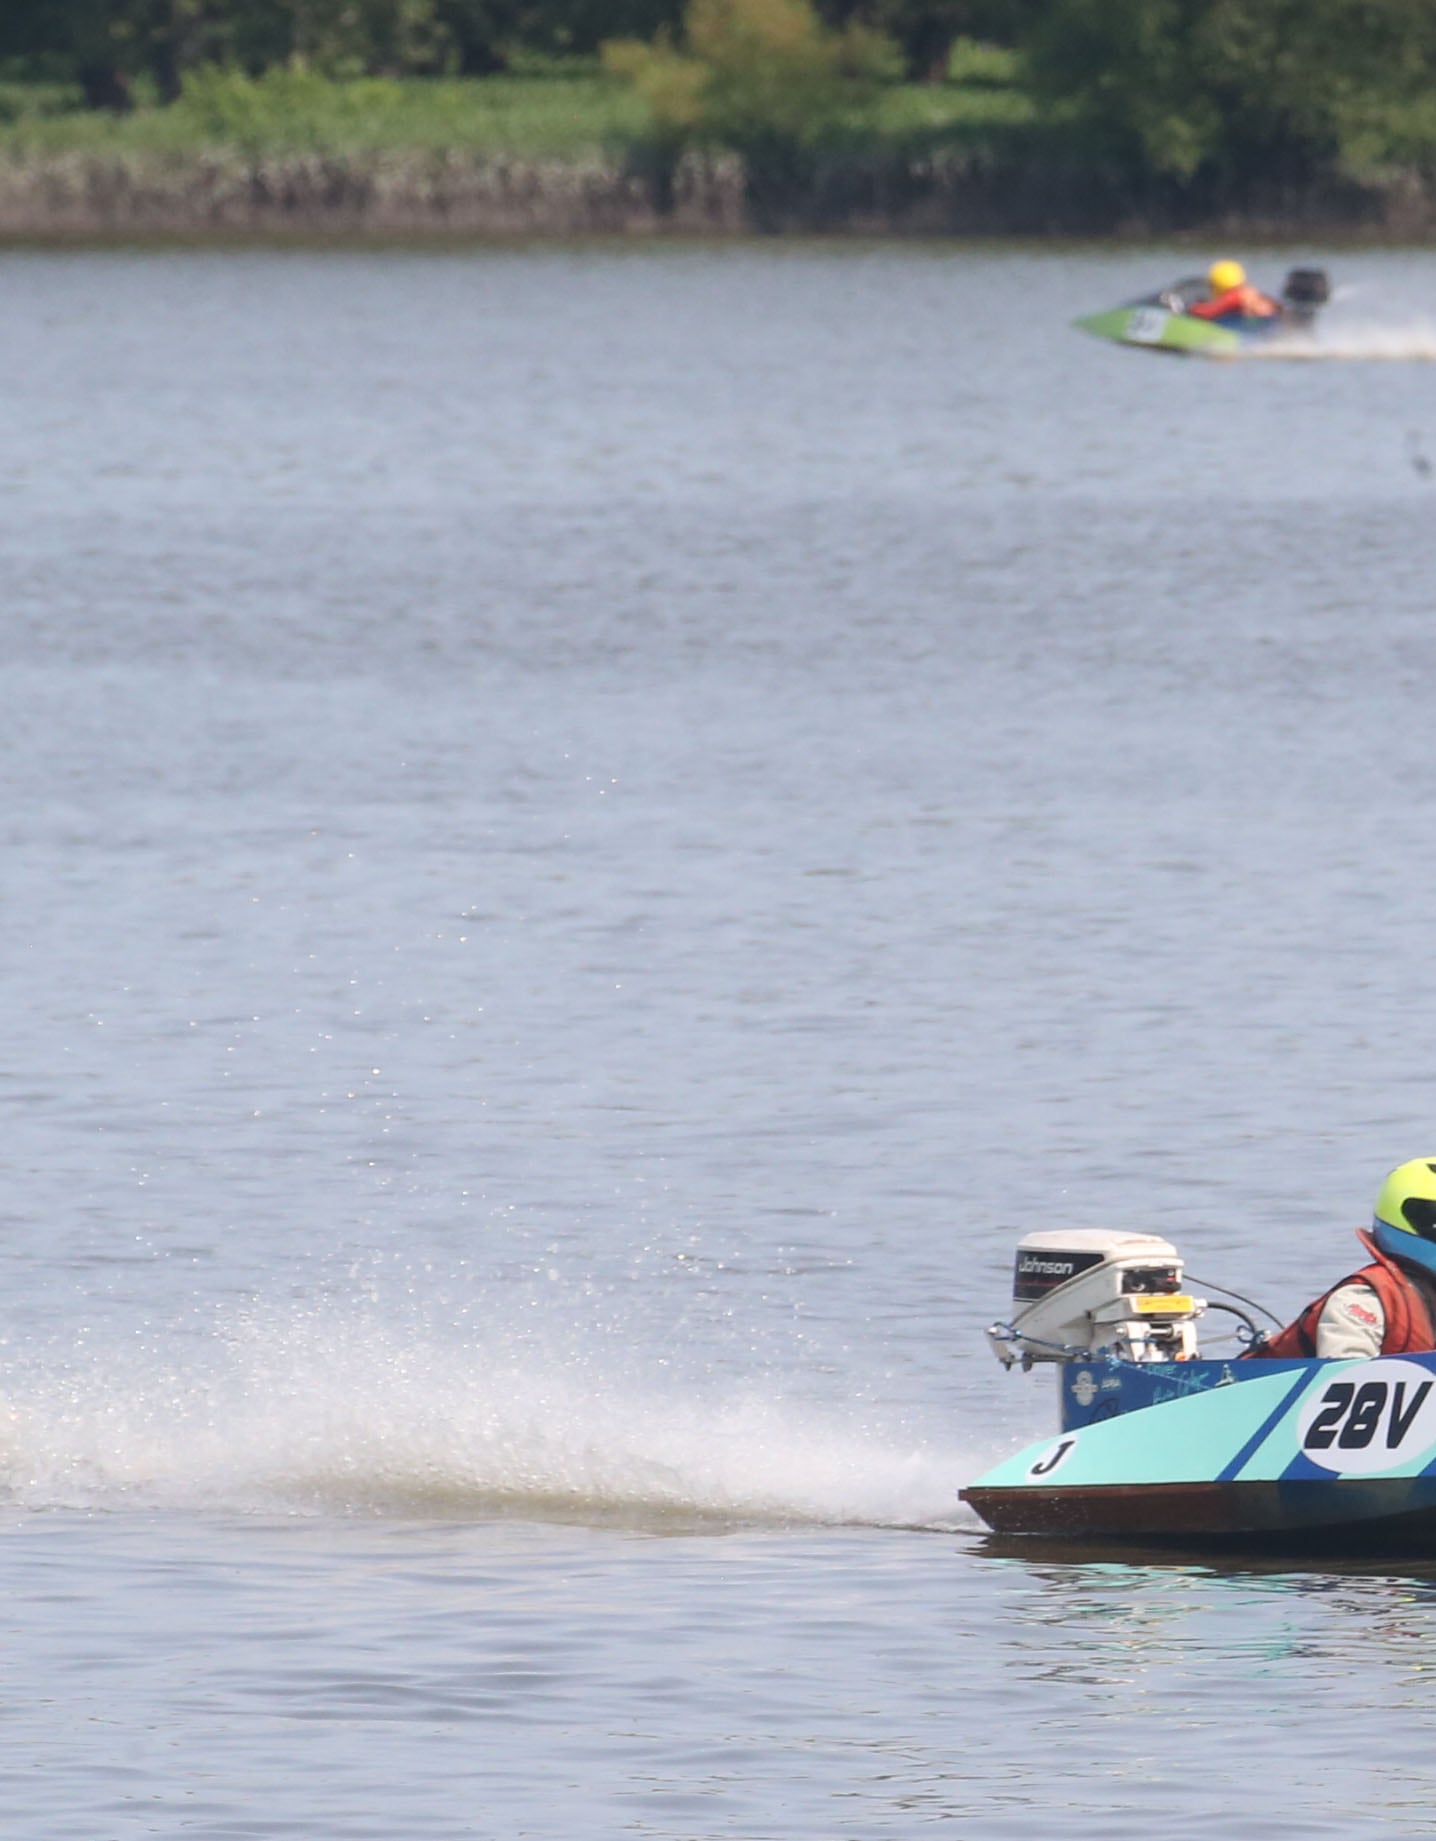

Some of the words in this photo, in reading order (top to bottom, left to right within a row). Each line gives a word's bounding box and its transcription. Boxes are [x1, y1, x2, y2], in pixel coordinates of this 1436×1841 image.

[1019, 1257, 1073, 1274] Johnson
[1304, 1381, 1434, 1449] 28V
[1031, 1440, 1075, 1475] J
